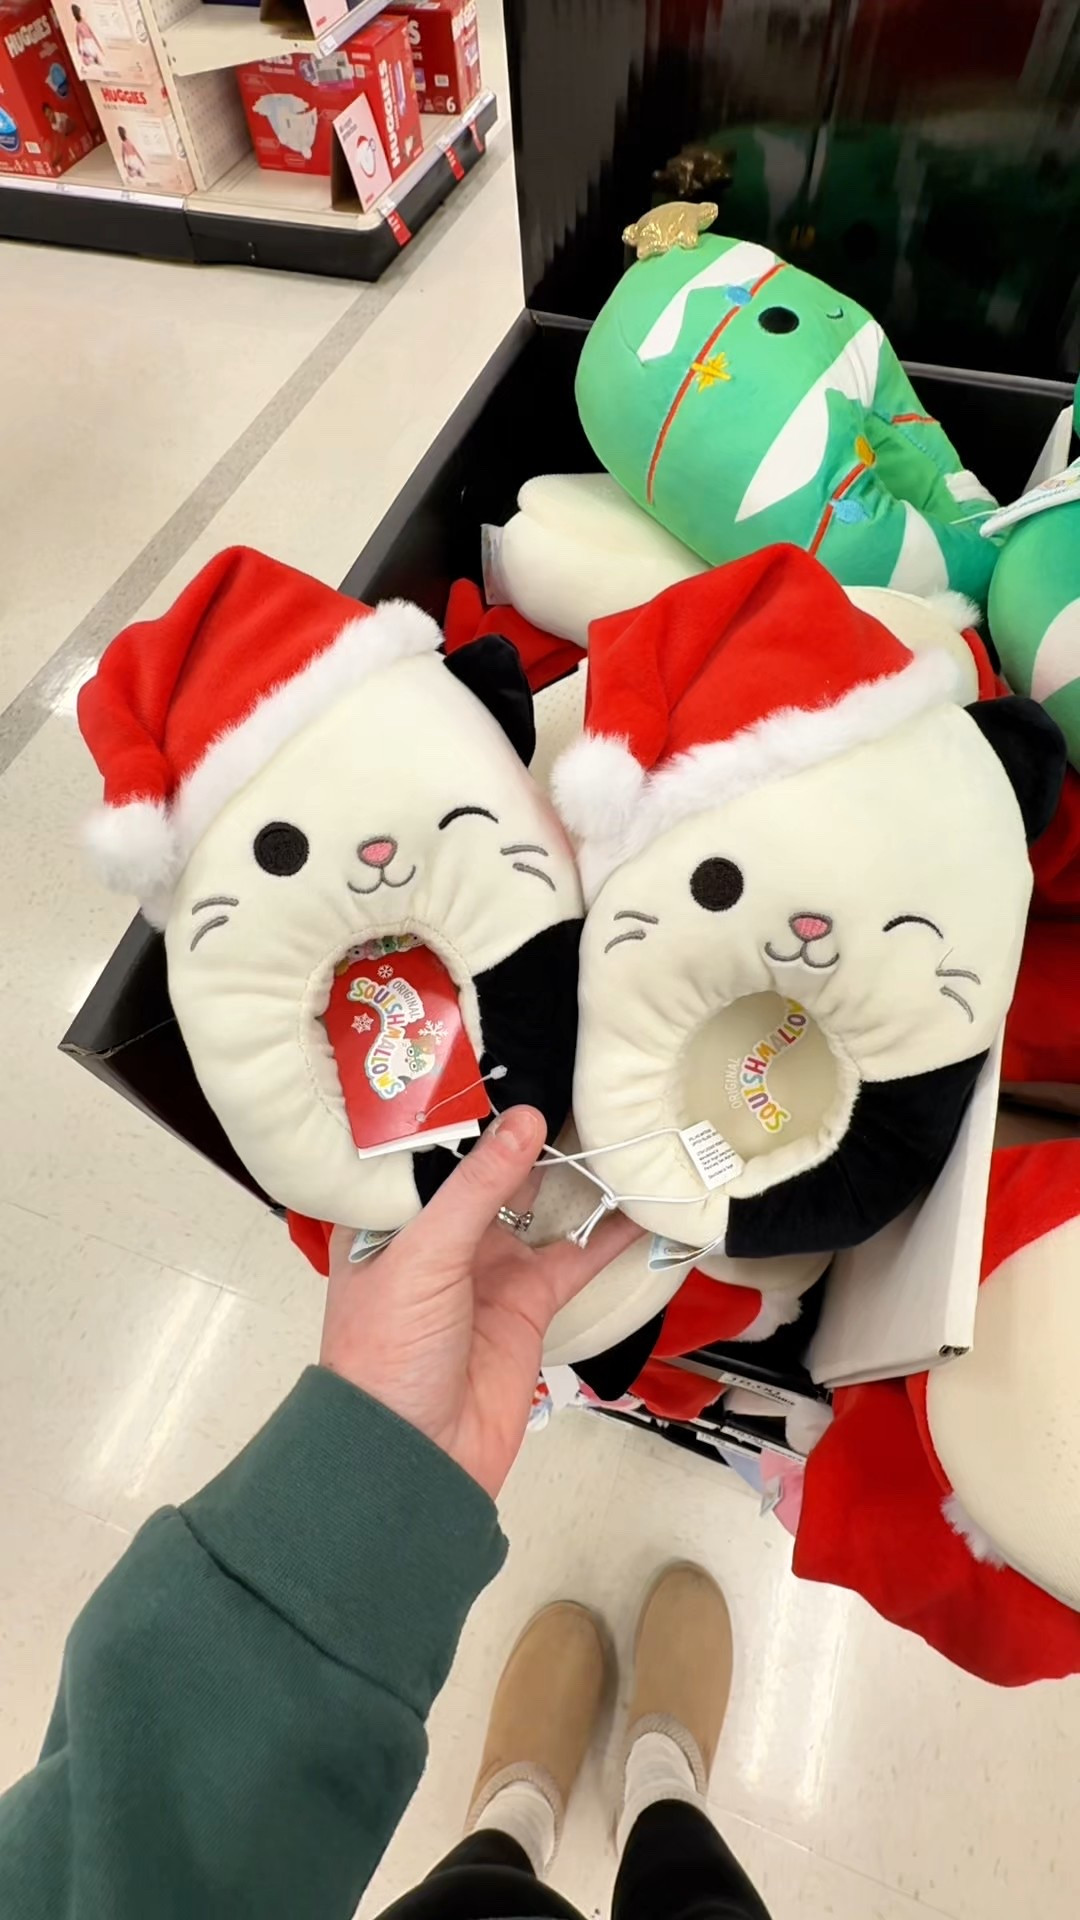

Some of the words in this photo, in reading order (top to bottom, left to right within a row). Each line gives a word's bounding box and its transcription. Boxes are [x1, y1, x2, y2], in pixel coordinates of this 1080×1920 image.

[4, 14, 52, 59] HUGGIES
[101, 87, 147, 105] HUGGIES
[378, 59, 400, 168] HUGGIES
[446, 96, 456, 113] 6
[392, 980, 421, 1018] ORIGINAL
[353, 980, 404, 1095] SQUISHMALLOWS
[724, 1057, 743, 1110] ORIGINAL
